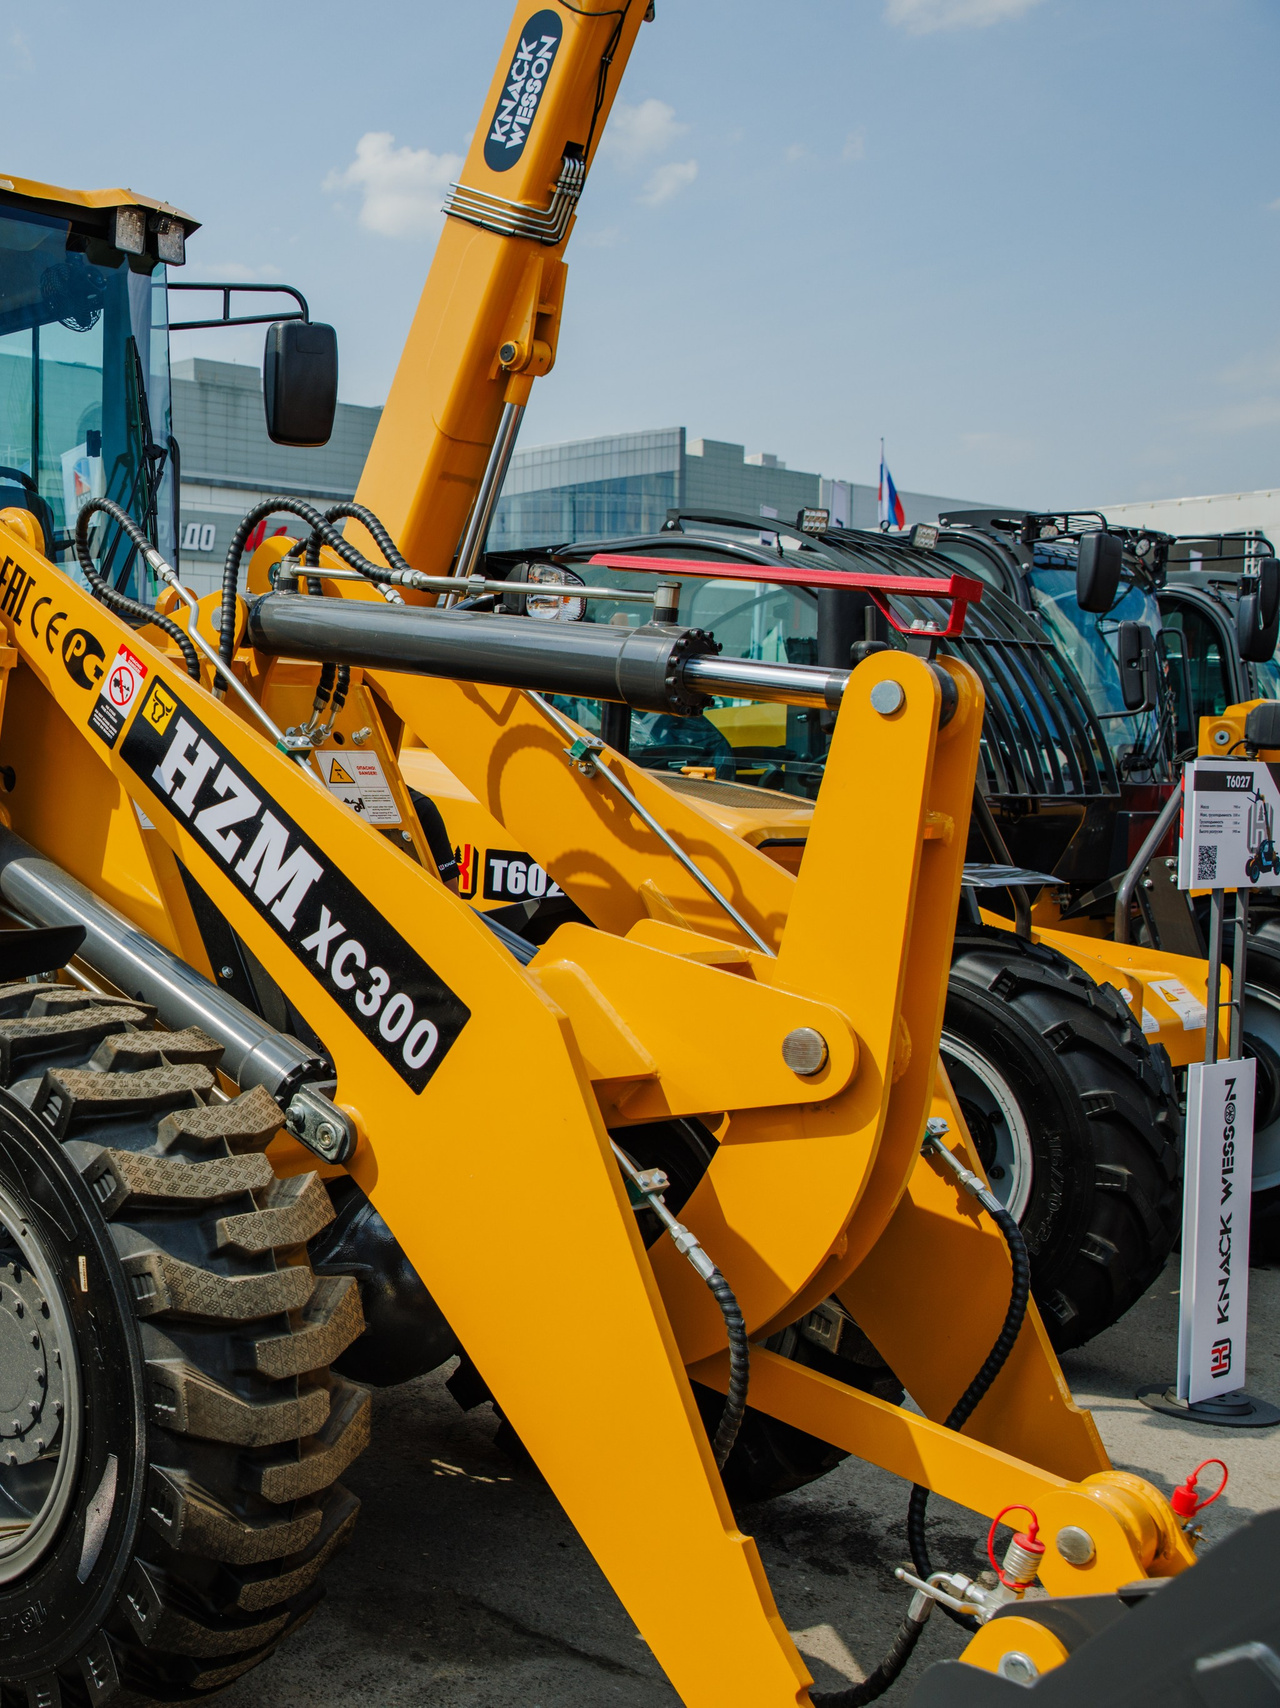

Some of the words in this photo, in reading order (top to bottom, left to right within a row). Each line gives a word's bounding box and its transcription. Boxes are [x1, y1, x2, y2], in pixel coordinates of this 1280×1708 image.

[490, 37, 538, 142] KNACK
[505, 35, 557, 149] WIESSON
[1226, 775, 1251, 788] T6027
[152, 716, 324, 932] HZM
[301, 904, 439, 1069] XC300
[1221, 1077, 1237, 1206] WIESSON
[1217, 1212, 1233, 1325] KNACK
